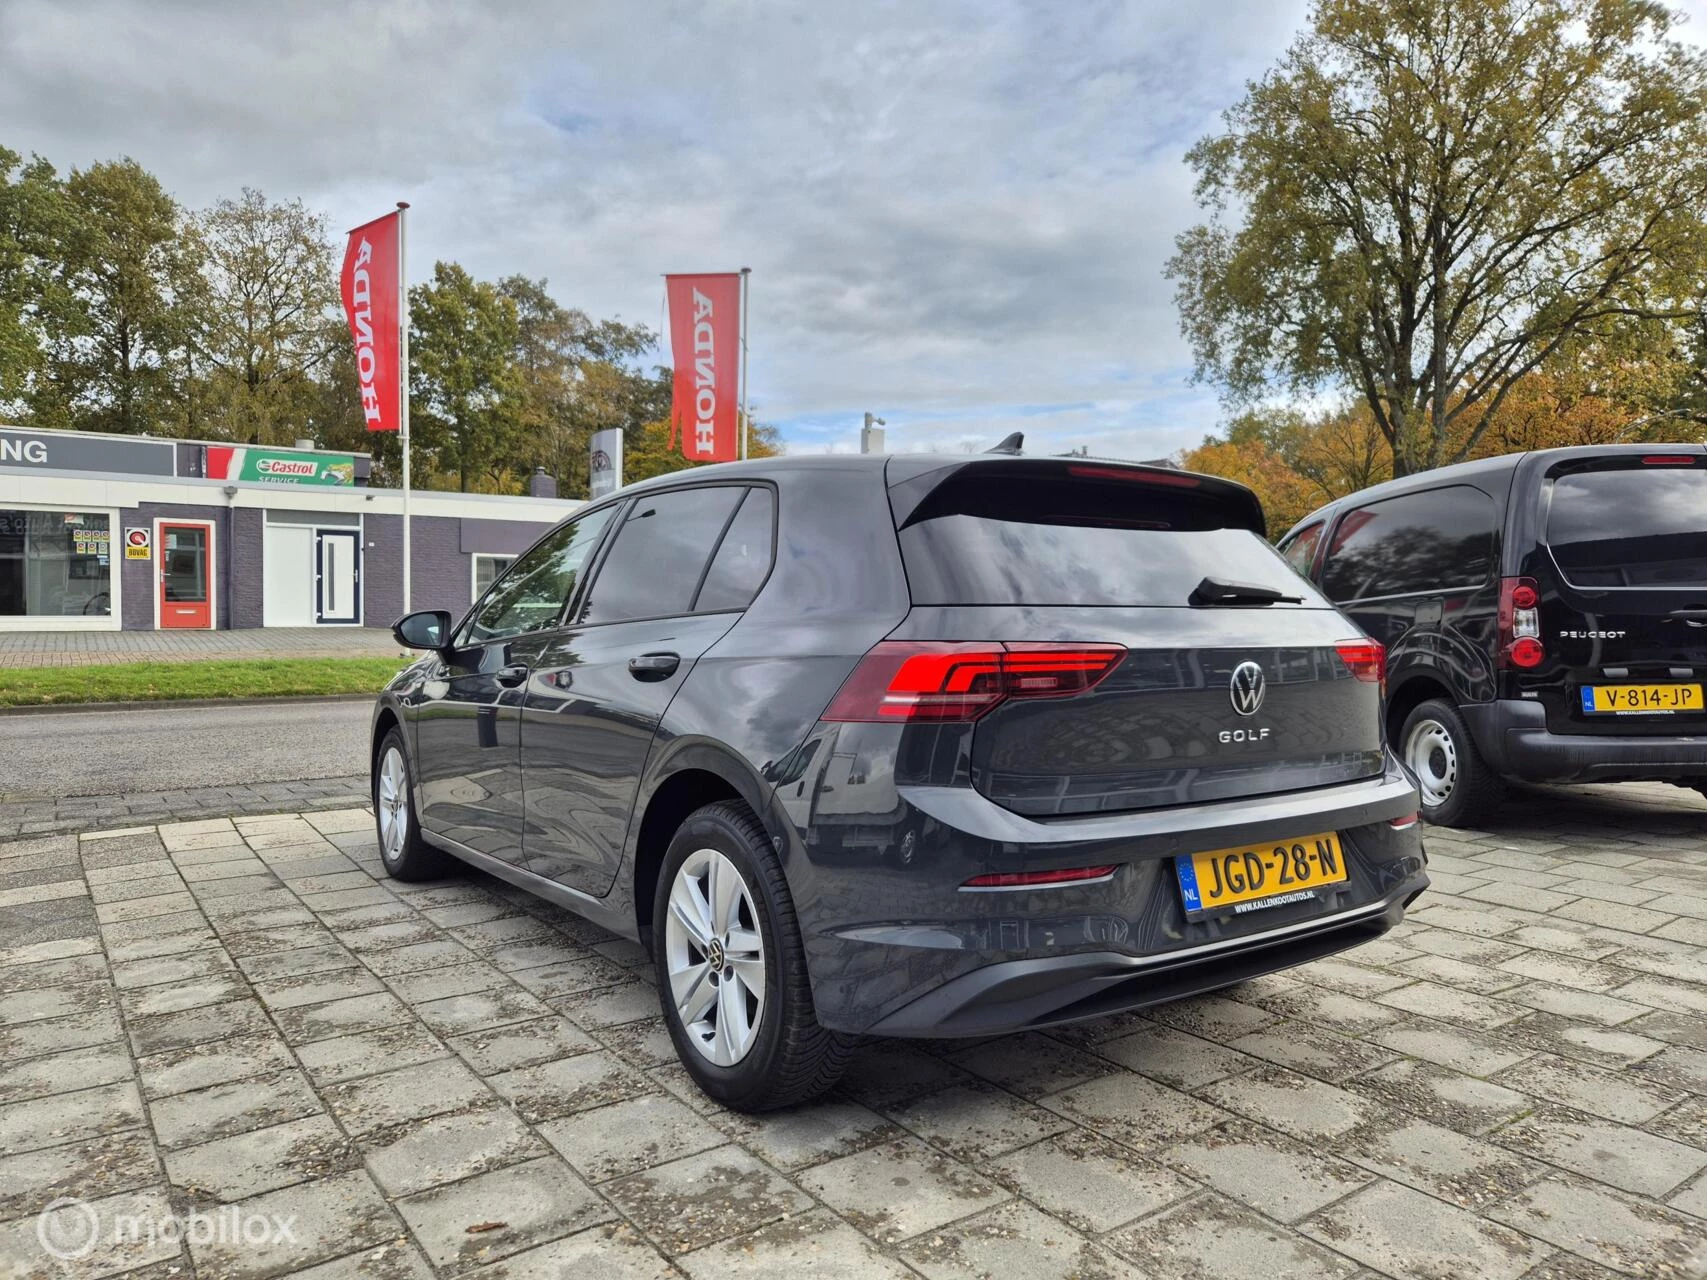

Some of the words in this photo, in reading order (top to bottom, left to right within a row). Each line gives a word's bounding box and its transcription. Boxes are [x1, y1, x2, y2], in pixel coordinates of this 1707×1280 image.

[353, 236, 381, 424] HONDA
[692, 286, 716, 456] HONDA
[0, 438, 48, 463] NG
[271, 461, 314, 475] Castrol
[1606, 688, 1692, 707] V-814-JP
[1219, 728, 1271, 743] GOLF
[1183, 889, 1199, 901] NL
[1209, 838, 1338, 899] JGD-28-N
[1234, 890, 1316, 914] WWW.KALLENKOOTAUTOS.NL
